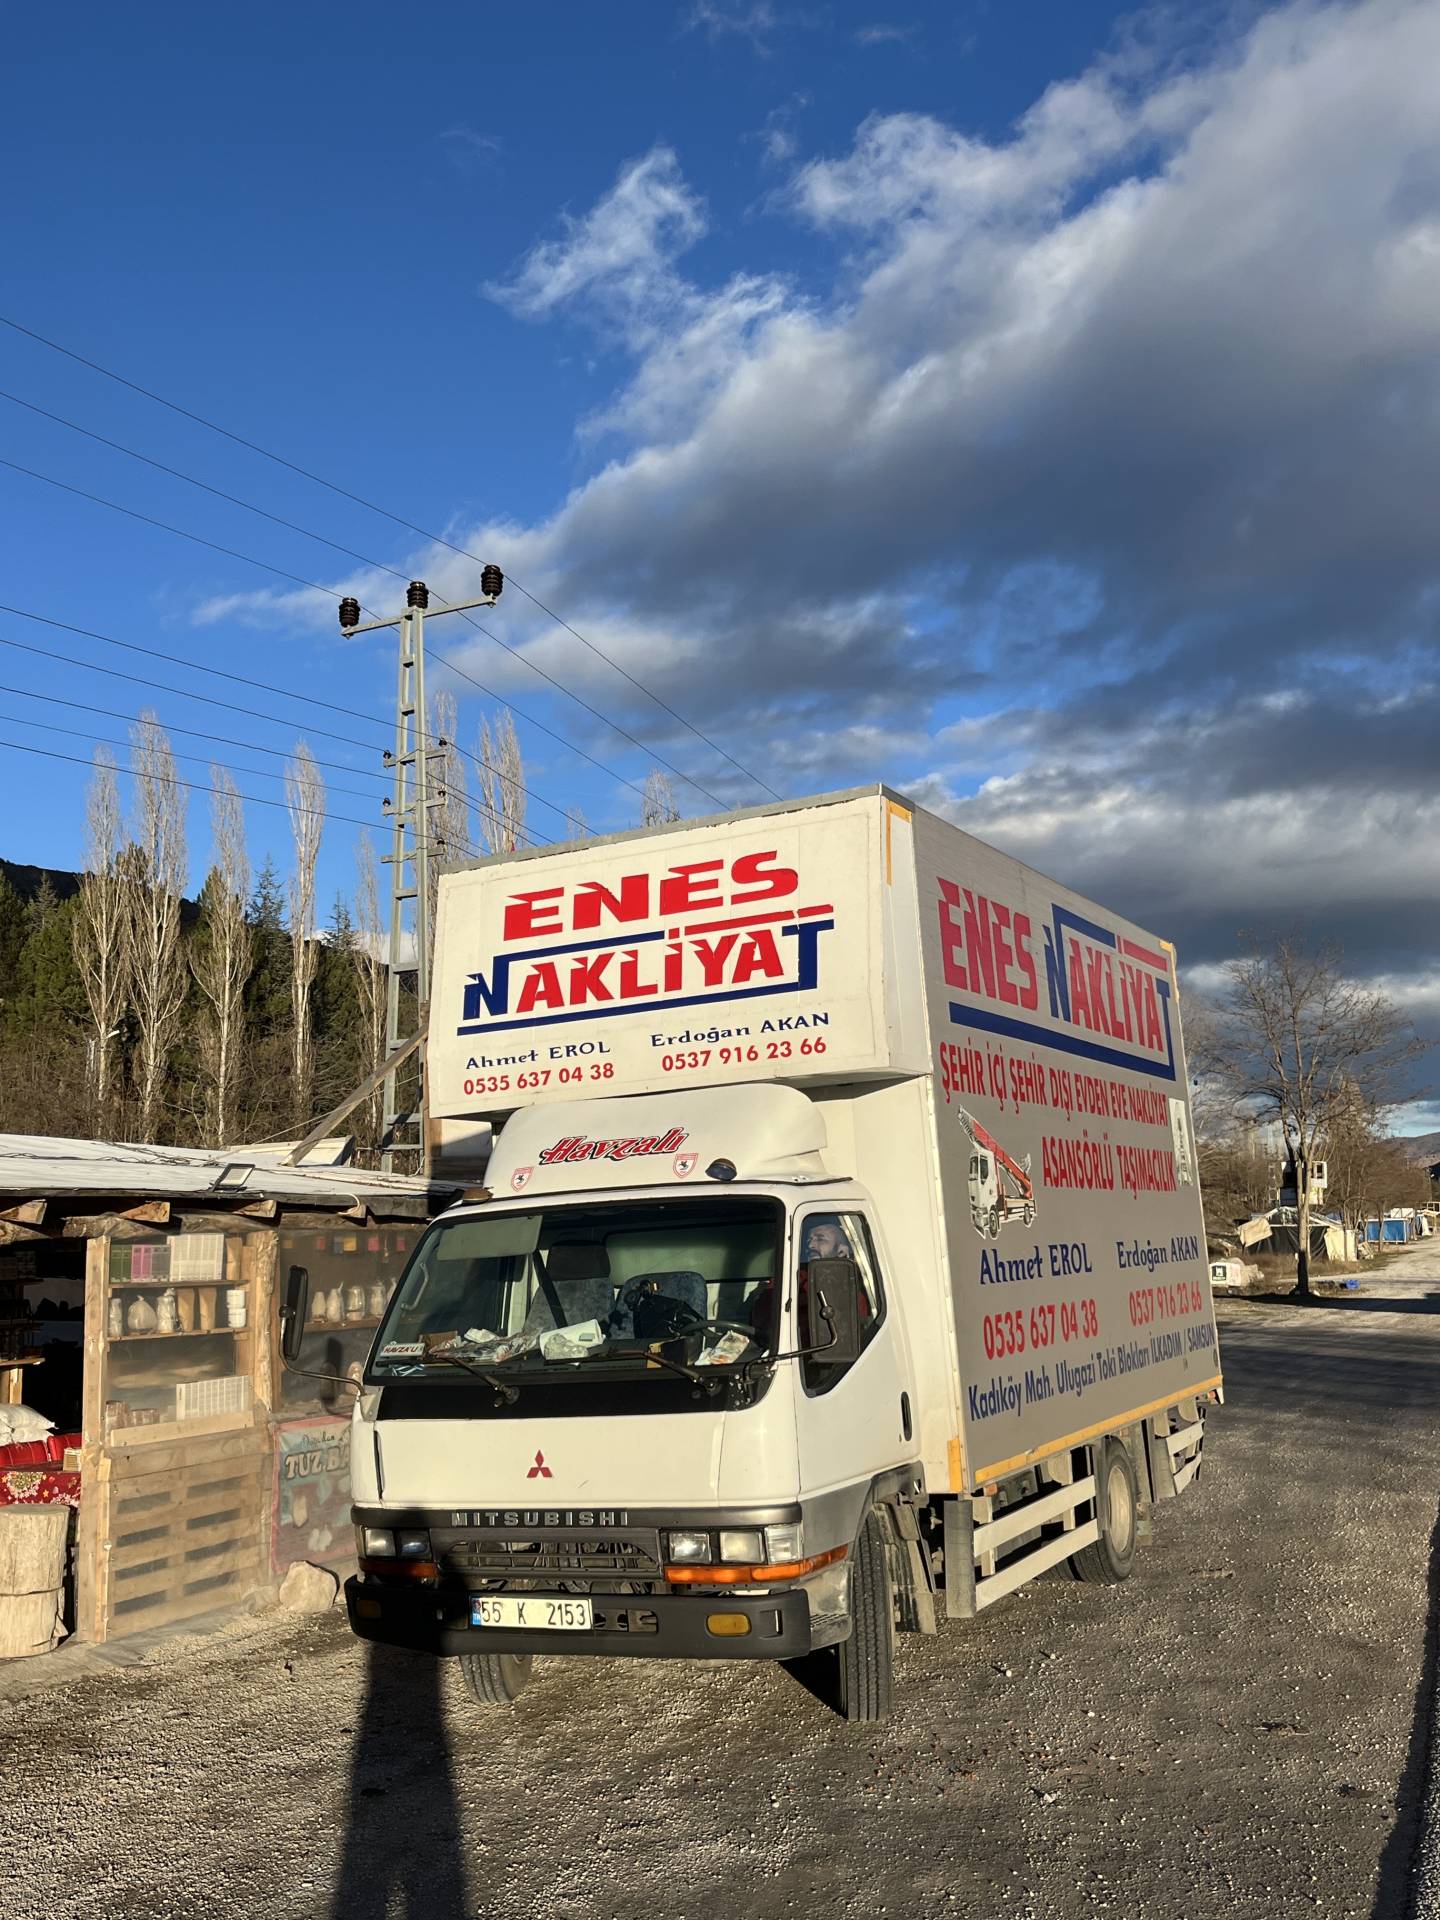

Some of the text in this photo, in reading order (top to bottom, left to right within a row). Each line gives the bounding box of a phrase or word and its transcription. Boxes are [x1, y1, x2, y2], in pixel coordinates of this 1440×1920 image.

[503, 850, 798, 942] ENES
[462, 918, 835, 1022] NAKLİYAT
[936, 875, 1173, 1072] ENES NAKLİYAT
[650, 1012, 829, 1047] Erdoğan AKAN
[466, 1041, 611, 1070] Ahmet EROL
[661, 1036, 827, 1072] 0537 916 23 66
[463, 1062, 615, 1095] 0535 637 04 38
[939, 1036, 1169, 1127] ŞEHİR İÇİ ŞEHİR DIŞI EVDEN EVE NAKLİYAT
[1041, 1129, 1115, 1191] ASANSÖRLÜ
[1115, 1144, 1177, 1200] TAŞIMACILIK
[979, 1242, 1093, 1285] Ahmet EROL
[1116, 1235, 1200, 1273] Erdoğan AKAN
[1128, 1280, 1202, 1327] 0537 916 23 66
[982, 1298, 1099, 1361] 0535 637 04 38
[968, 1375, 1022, 1422] Kadıköy
[1024, 1365, 1054, 1404] Mah.
[1055, 1353, 1096, 1398] Ulugazi
[1096, 1349, 1117, 1382] Toki
[1117, 1339, 1150, 1375] Blokları
[1149, 1331, 1183, 1364] İLKADIM
[1187, 1322, 1216, 1353] SAMSUN
[285, 1445, 351, 1481] TUZ BA
[451, 1511, 628, 1527] MITSUBISHI
[481, 1601, 502, 1623] 55
[517, 1602, 526, 1625] K
[547, 1602, 586, 1626] 2153
